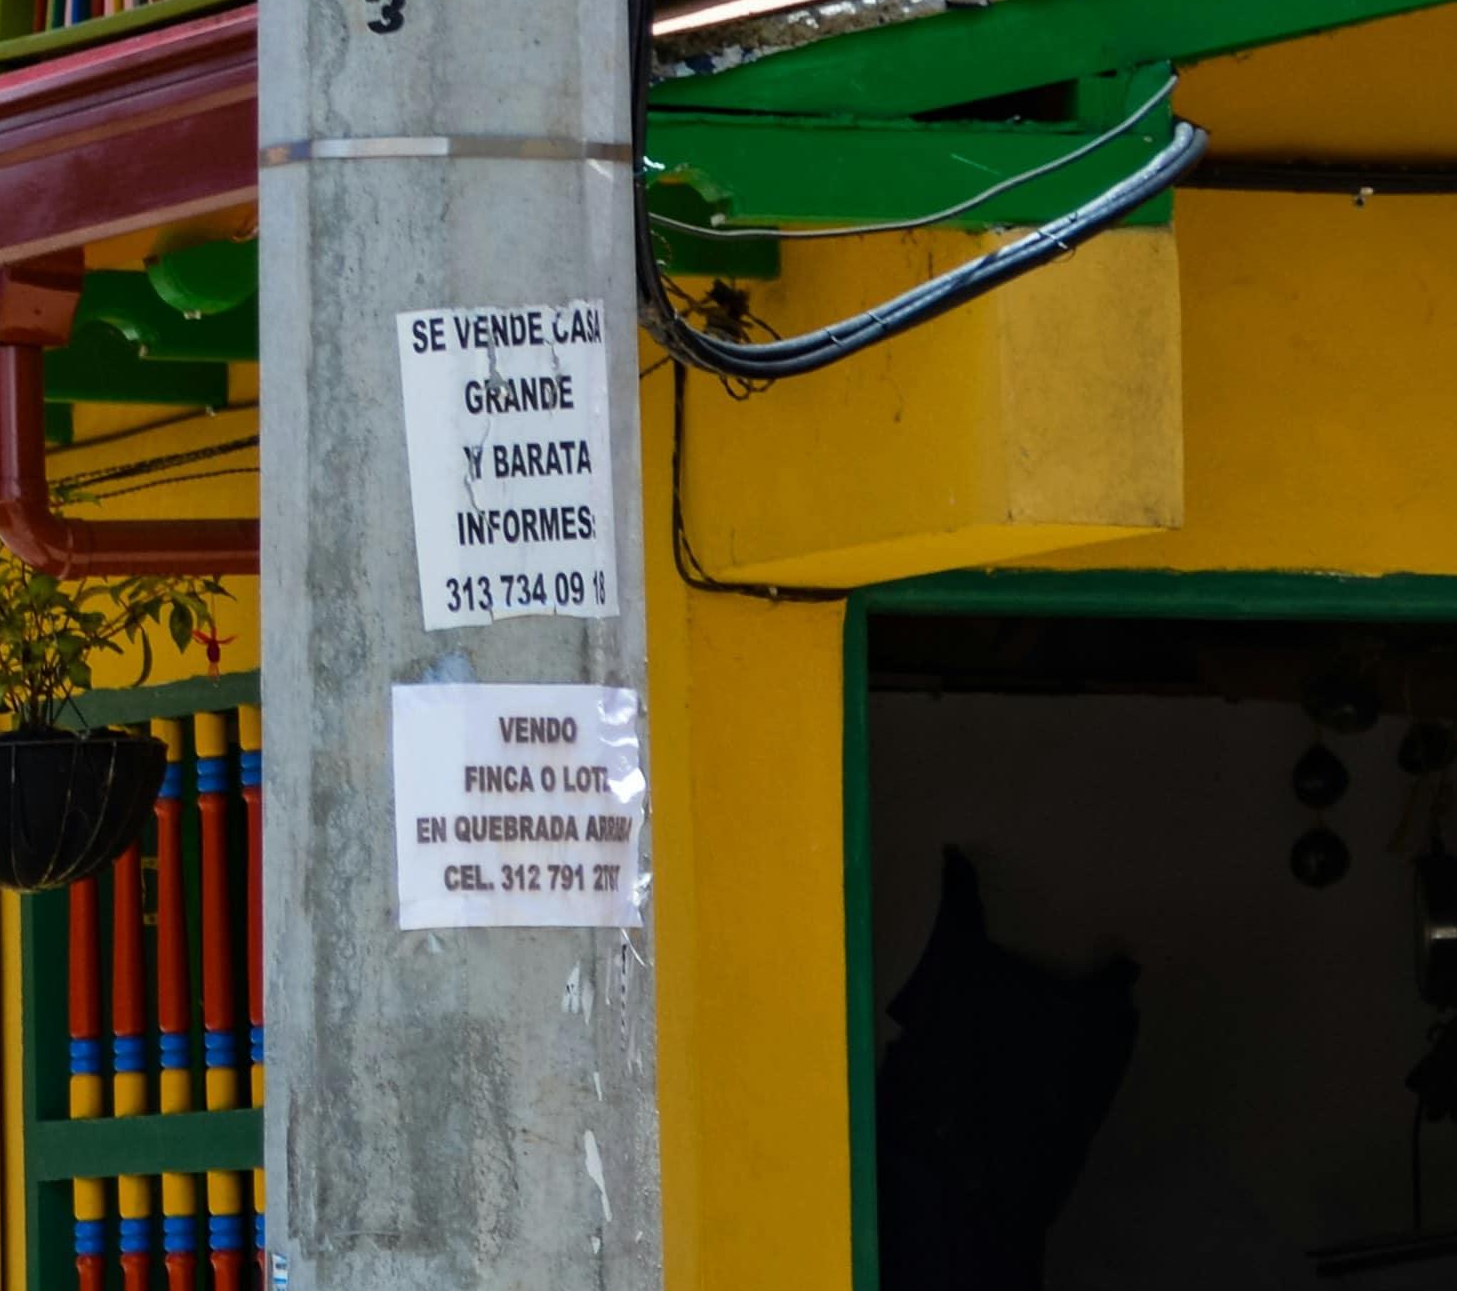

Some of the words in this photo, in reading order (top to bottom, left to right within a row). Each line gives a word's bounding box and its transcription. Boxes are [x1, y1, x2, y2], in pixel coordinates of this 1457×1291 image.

[412, 318, 446, 354] SE
[454, 311, 545, 350] VENDE
[552, 309, 603, 345] CASA
[465, 375, 574, 415] GRANDE
[463, 445, 483, 480] Y
[493, 440, 592, 478] BARATA
[457, 505, 596, 545] INFORMES:
[446, 576, 493, 612] 313
[500, 573, 547, 608] 734
[555, 571, 585, 605] 09
[593, 570, 606, 605] 18
[499, 716, 577, 744] VENDO
[465, 766, 534, 793] FINCA
[540, 766, 556, 793] O
[416, 817, 446, 844] EN
[454, 815, 579, 843] QUEBRADA
[444, 864, 494, 892] CEL.
[501, 864, 541, 891] 312
[548, 863, 585, 891] 791
